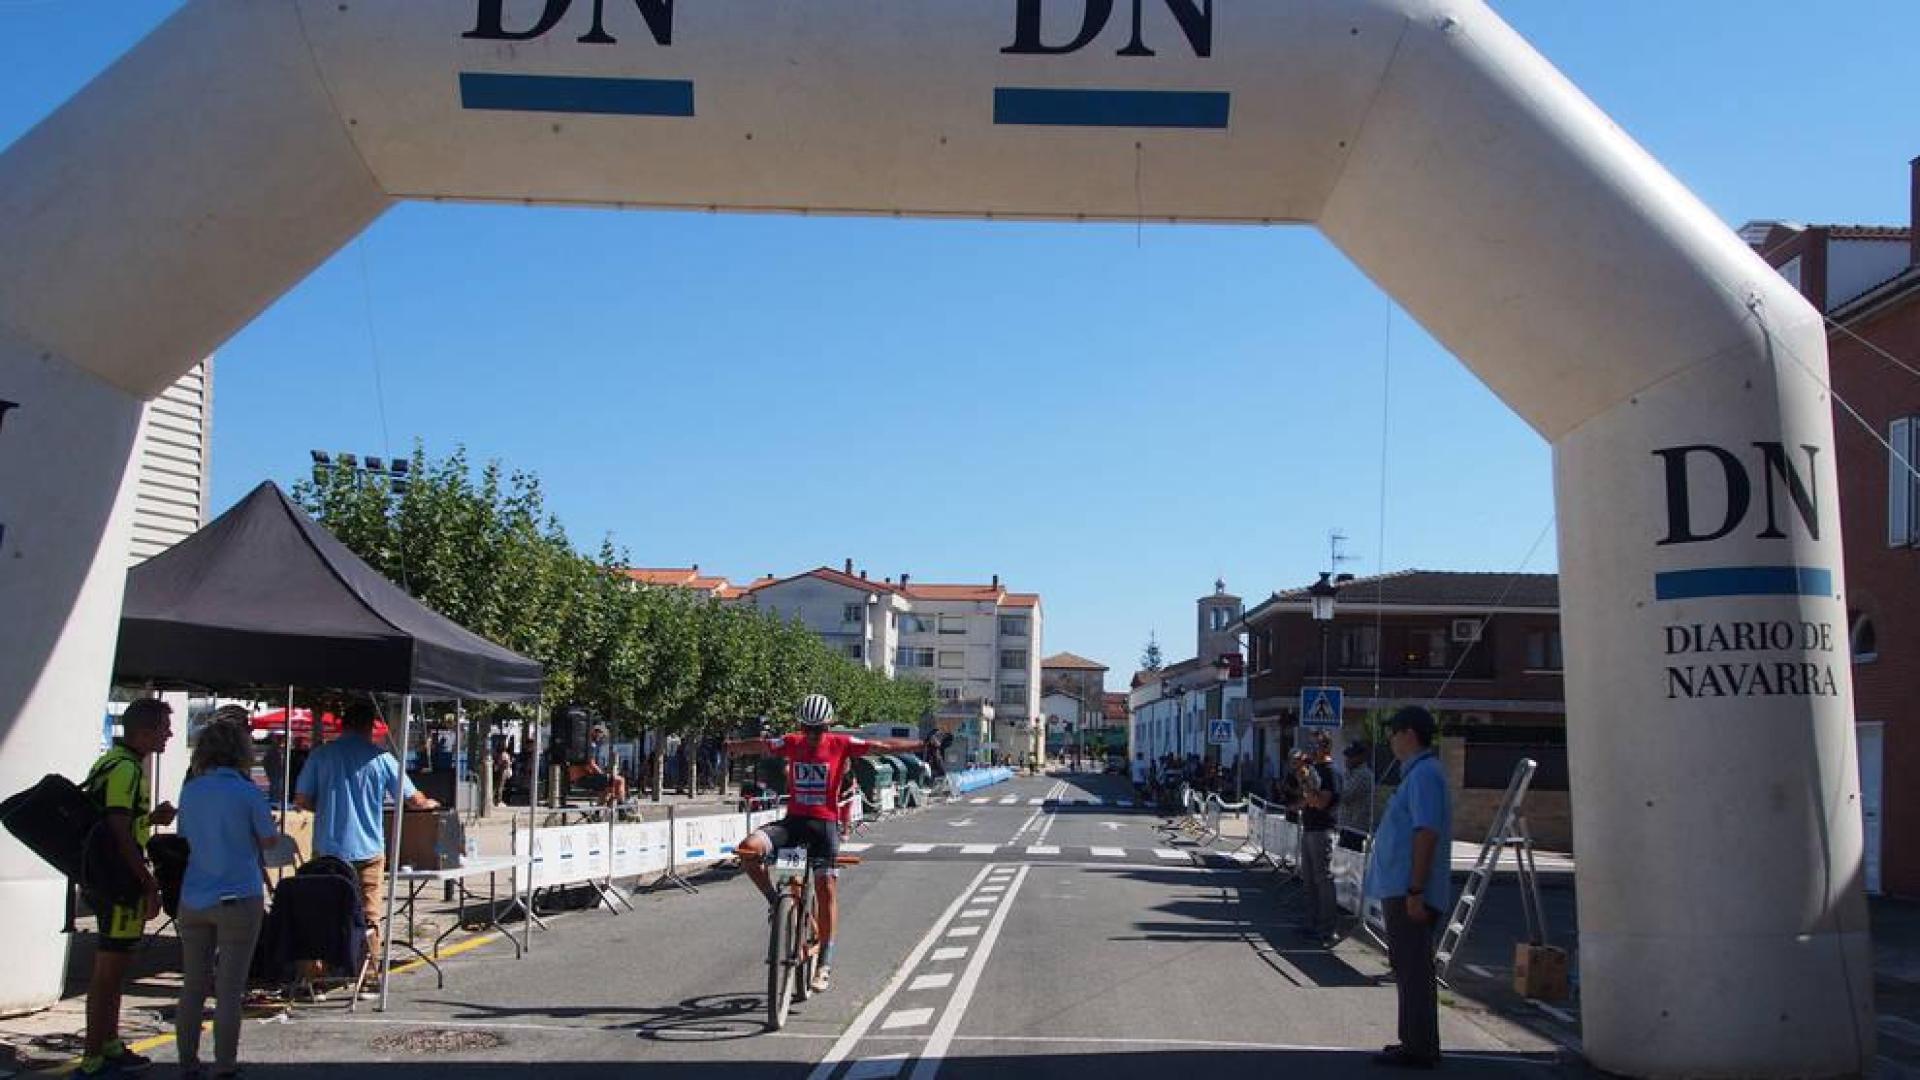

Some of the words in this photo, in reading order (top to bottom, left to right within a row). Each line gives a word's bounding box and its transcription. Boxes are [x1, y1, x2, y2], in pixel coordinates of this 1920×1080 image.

[1652, 441, 1821, 545] DN
[1664, 621, 1794, 654] DIARIO
[1800, 622, 1834, 652] DE
[1665, 662, 1838, 699] NAVARRA
[795, 764, 827, 781] DN
